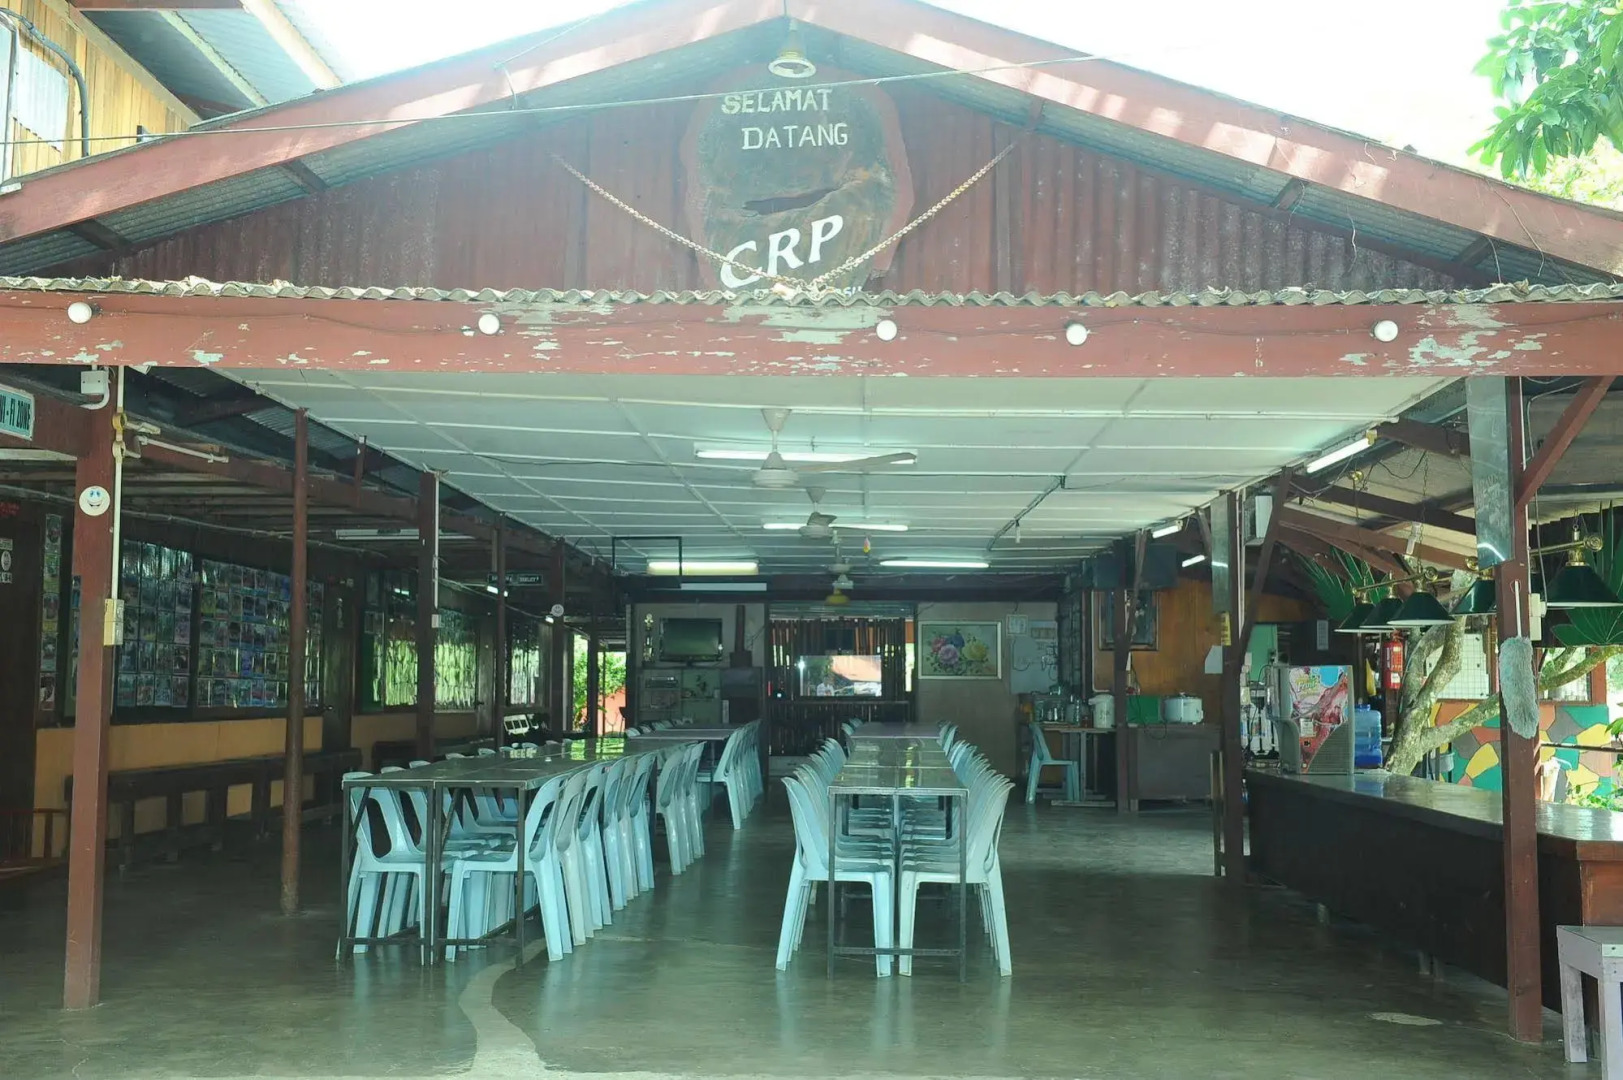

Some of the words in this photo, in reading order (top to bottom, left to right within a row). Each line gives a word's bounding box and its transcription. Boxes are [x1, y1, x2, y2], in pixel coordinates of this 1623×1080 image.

[721, 88, 833, 114] SELAMAT
[741, 122, 848, 150] DATANG
[720, 214, 844, 289] CRP
